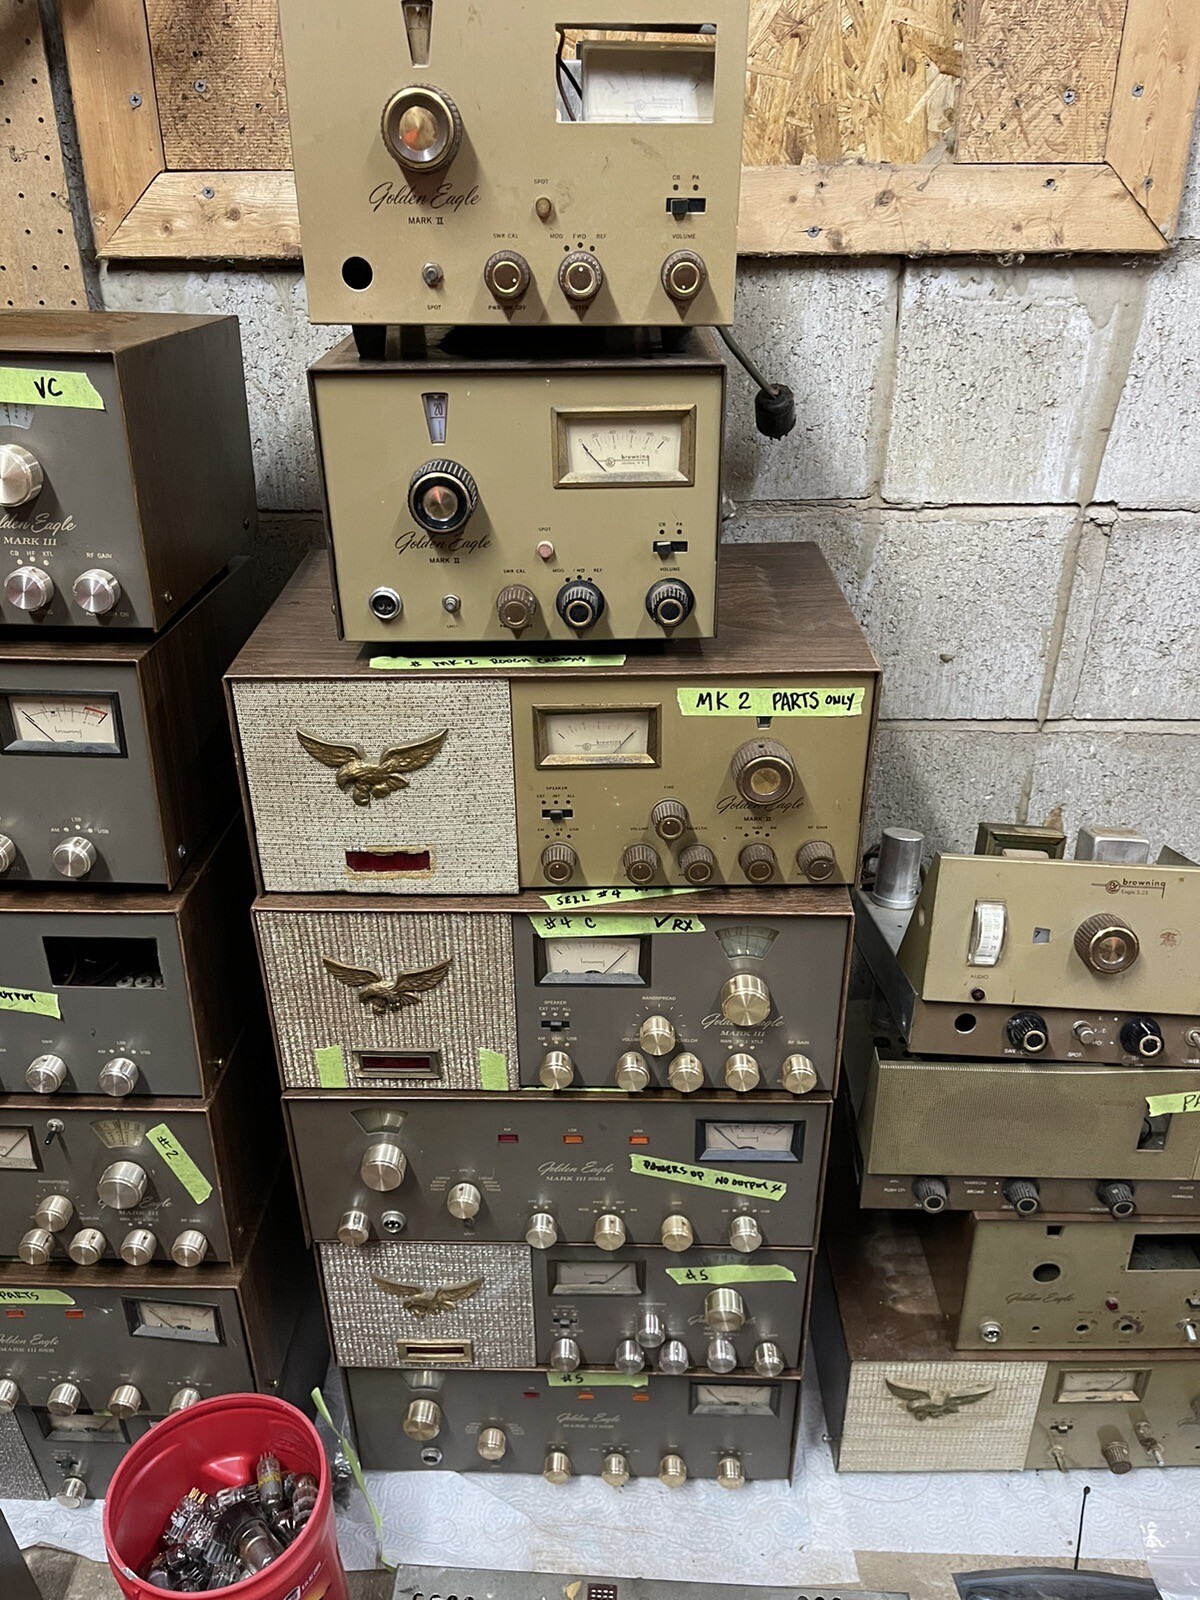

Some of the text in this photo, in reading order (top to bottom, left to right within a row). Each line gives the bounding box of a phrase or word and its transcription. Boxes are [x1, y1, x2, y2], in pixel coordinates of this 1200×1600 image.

[368, 181, 482, 213] Golden Eagle
[408, 217, 445, 225] MARK II
[34, 376, 64, 399] VC
[433, 402, 443, 416] 20
[0, 512, 77, 536] lden Eagle
[3, 536, 57, 546] MARK III
[394, 530, 492, 555] Golden Eagle
[695, 691, 856, 712] MK 2 PARTS ONLY
[716, 795, 759, 814] Golden
[1122, 878, 1166, 896] browning
[556, 894, 590, 906] SELL
[544, 915, 694, 932] #4 C RX
[1034, 930, 1041, 938] 7
[0, 991, 37, 1003] UTPUT
[700, 1012, 735, 1030] Gold
[537, 1160, 615, 1177] Golden Eagle
[642, 1159, 688, 1175] POWERS
[715, 1176, 729, 1185] NO
[0, 1291, 40, 1301] PARTS
[29, 1333, 60, 1348] Eagle
